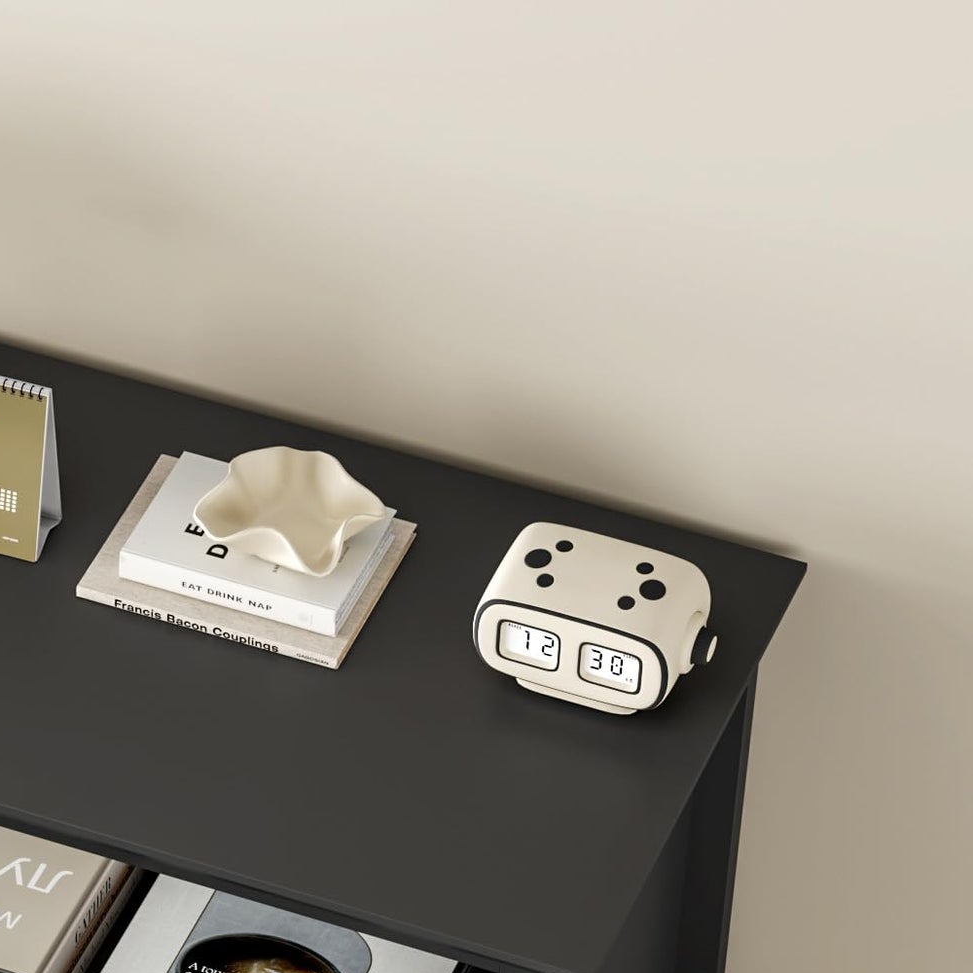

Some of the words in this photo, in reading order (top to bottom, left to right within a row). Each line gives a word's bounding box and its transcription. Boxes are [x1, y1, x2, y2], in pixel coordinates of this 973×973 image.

[181, 581, 202, 592] EAT
[207, 587, 243, 604] DRINK
[248, 599, 273, 611] NAP
[114, 599, 162, 621] Francis
[166, 613, 208, 633] Bacon
[212, 627, 279, 653] Couplings
[590, 648, 624, 676] 30
[188, 962, 198, 971] A
